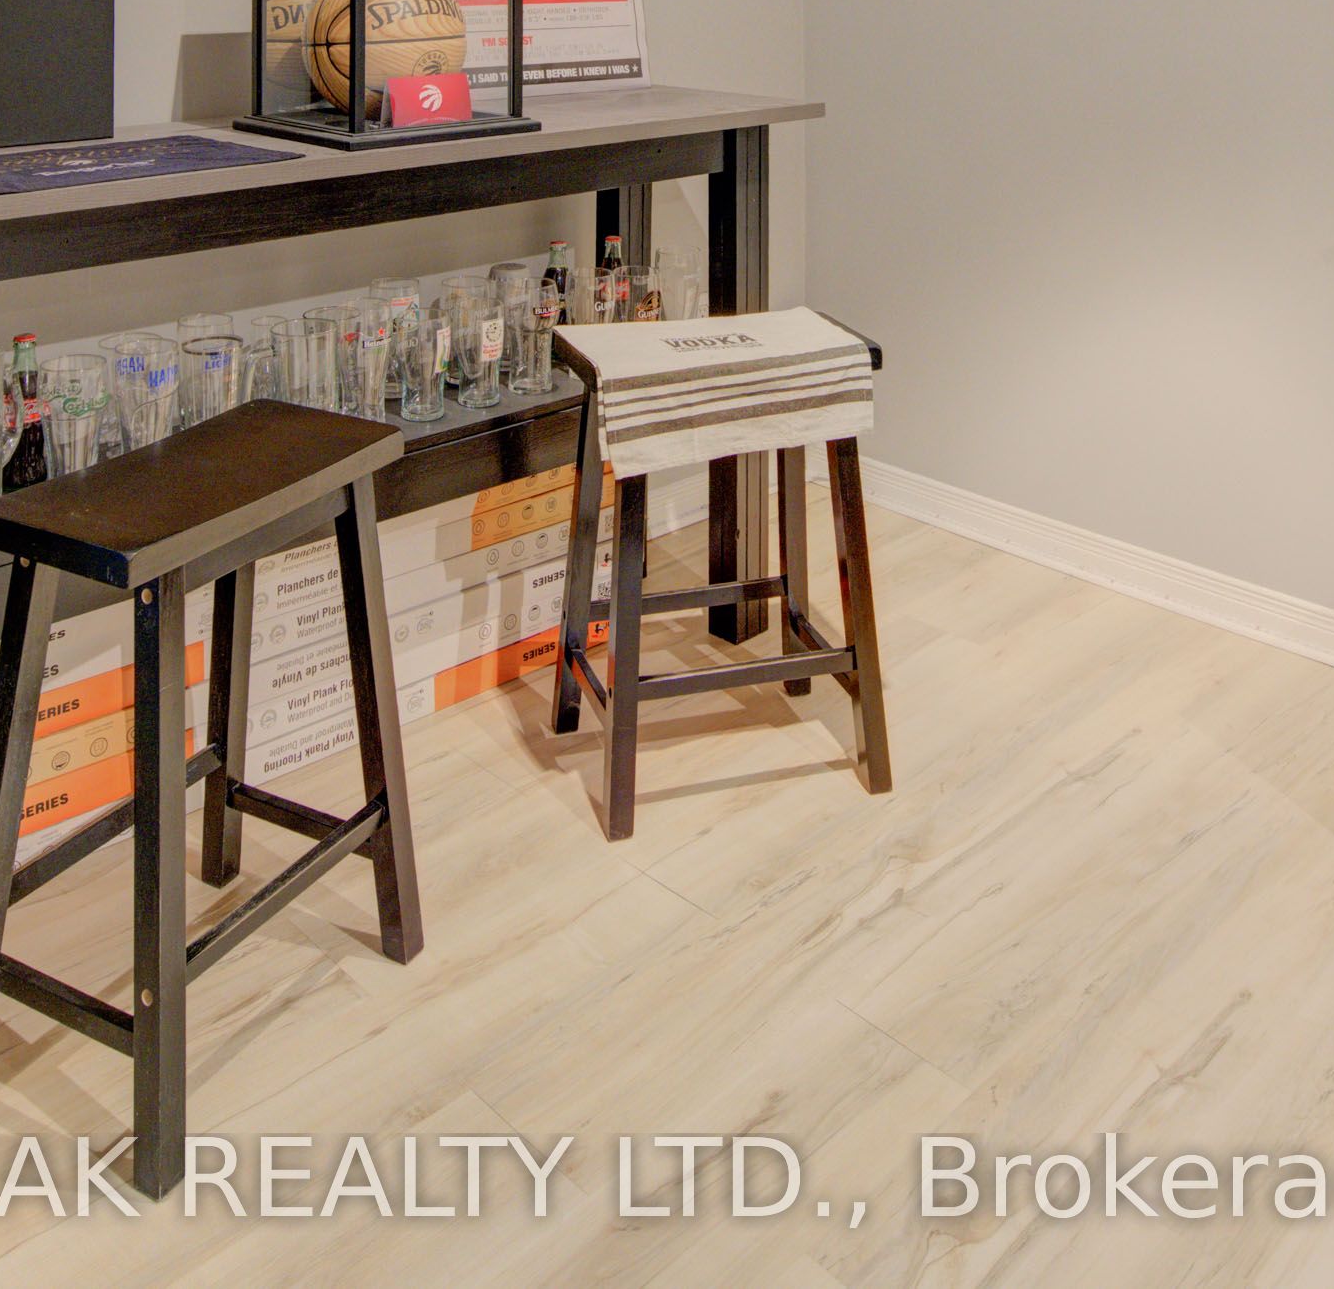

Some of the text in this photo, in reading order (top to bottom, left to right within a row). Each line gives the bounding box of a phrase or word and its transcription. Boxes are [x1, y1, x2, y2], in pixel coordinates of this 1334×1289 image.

[479, 73, 499, 84] SAID
[523, 69, 544, 80] EVEN
[546, 68, 577, 79] BEFORE
[583, 65, 607, 76] KNEW
[613, 64, 630, 74] WAS
[663, 334, 756, 349] VODKA
[284, 542, 331, 562] Planchers
[277, 569, 339, 596] Planchers de
[533, 570, 565, 589] SERIES
[297, 611, 319, 627] Vinyl
[297, 618, 337, 638] Waterproof
[523, 641, 556, 662] SERIES
[272, 654, 350, 688] nchers de Vinyle
[287, 693, 310, 710] Vinyl
[313, 683, 338, 702] Plank
[37, 699, 81, 722] ERIES
[287, 704, 328, 724] Waterproof
[264, 730, 355, 774] Vinyl Plank Flooring
